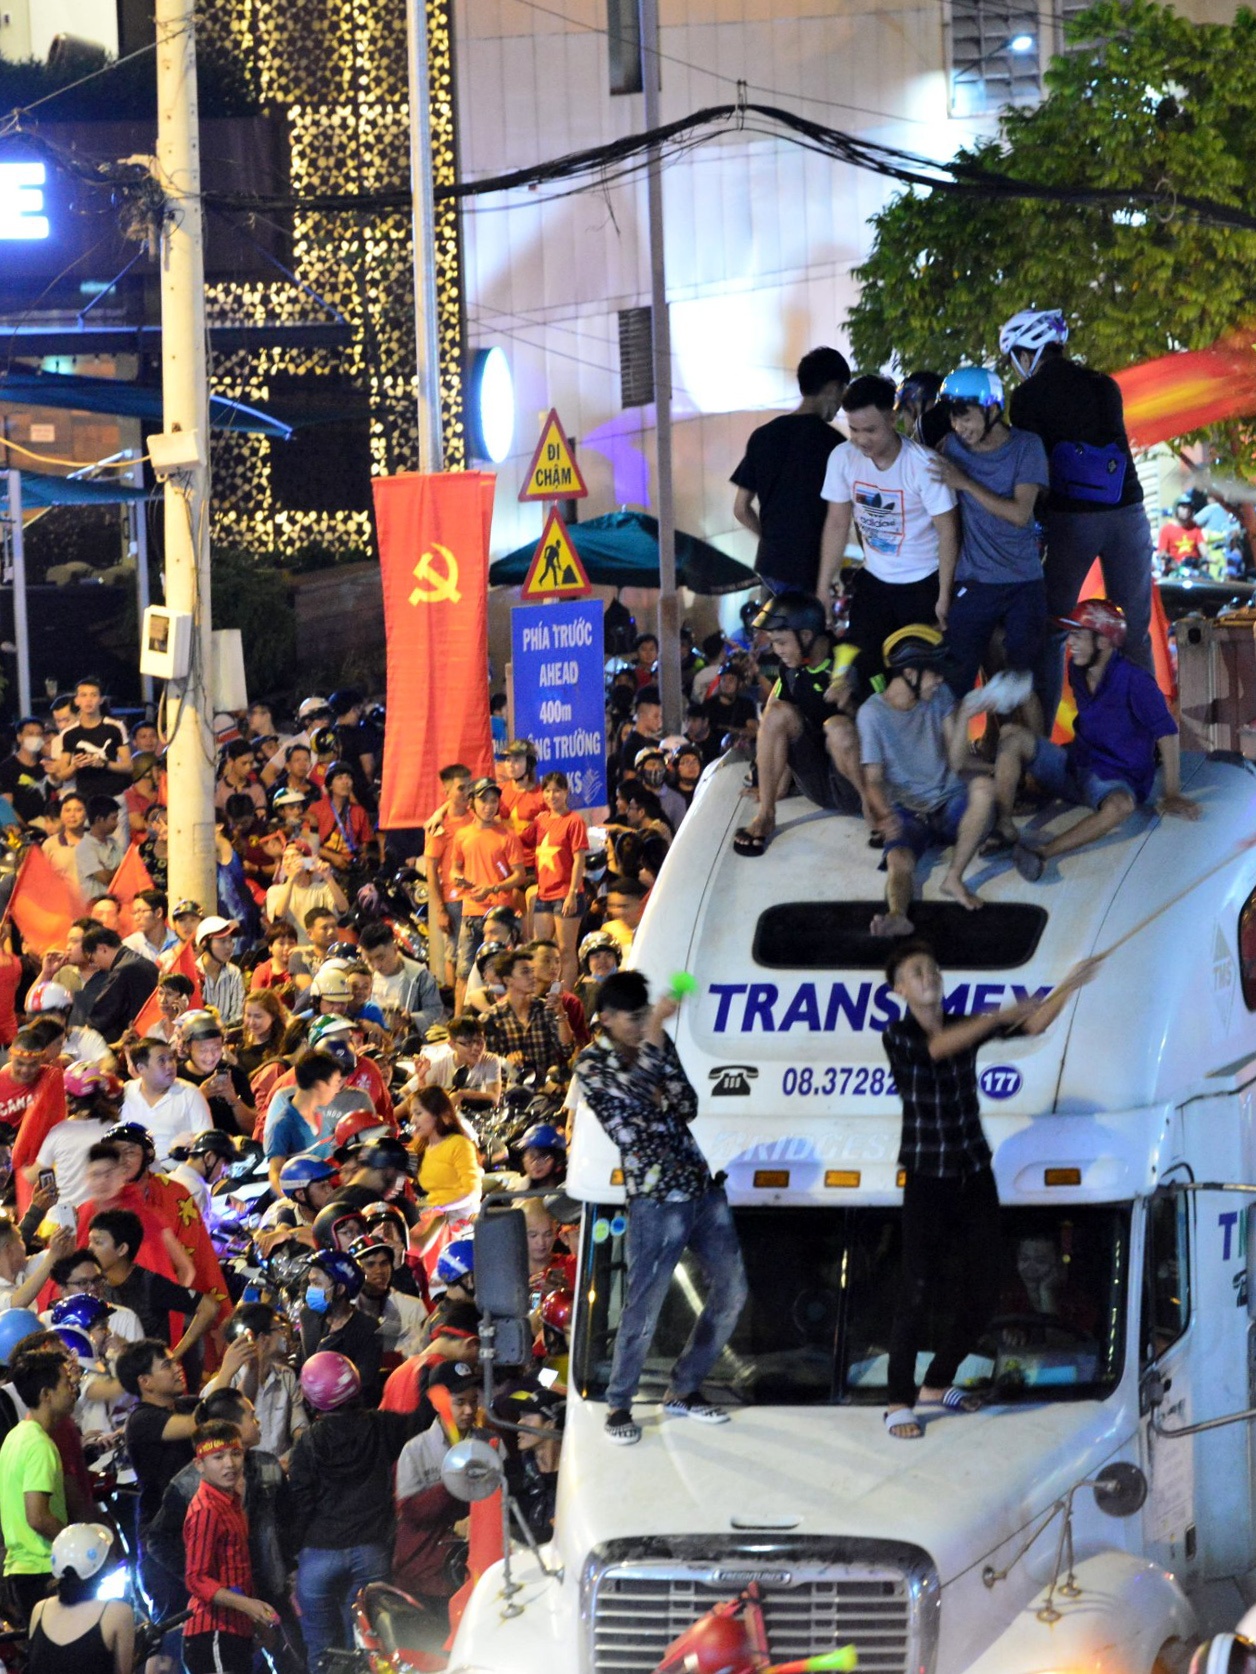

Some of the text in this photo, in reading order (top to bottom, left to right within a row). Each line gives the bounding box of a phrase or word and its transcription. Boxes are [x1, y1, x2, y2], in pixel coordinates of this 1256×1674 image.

[547, 444, 560, 461] ĐI
[535, 464, 571, 489] CHẬM
[522, 617, 593, 652] PHÍA TRƯỚC
[539, 661, 579, 687] AHEAD
[539, 700, 572, 725] 400m
[553, 728, 601, 760] TRƯỜNG
[708, 981, 1054, 1033] TRANSMEX
[981, 1068, 1022, 1093] 177
